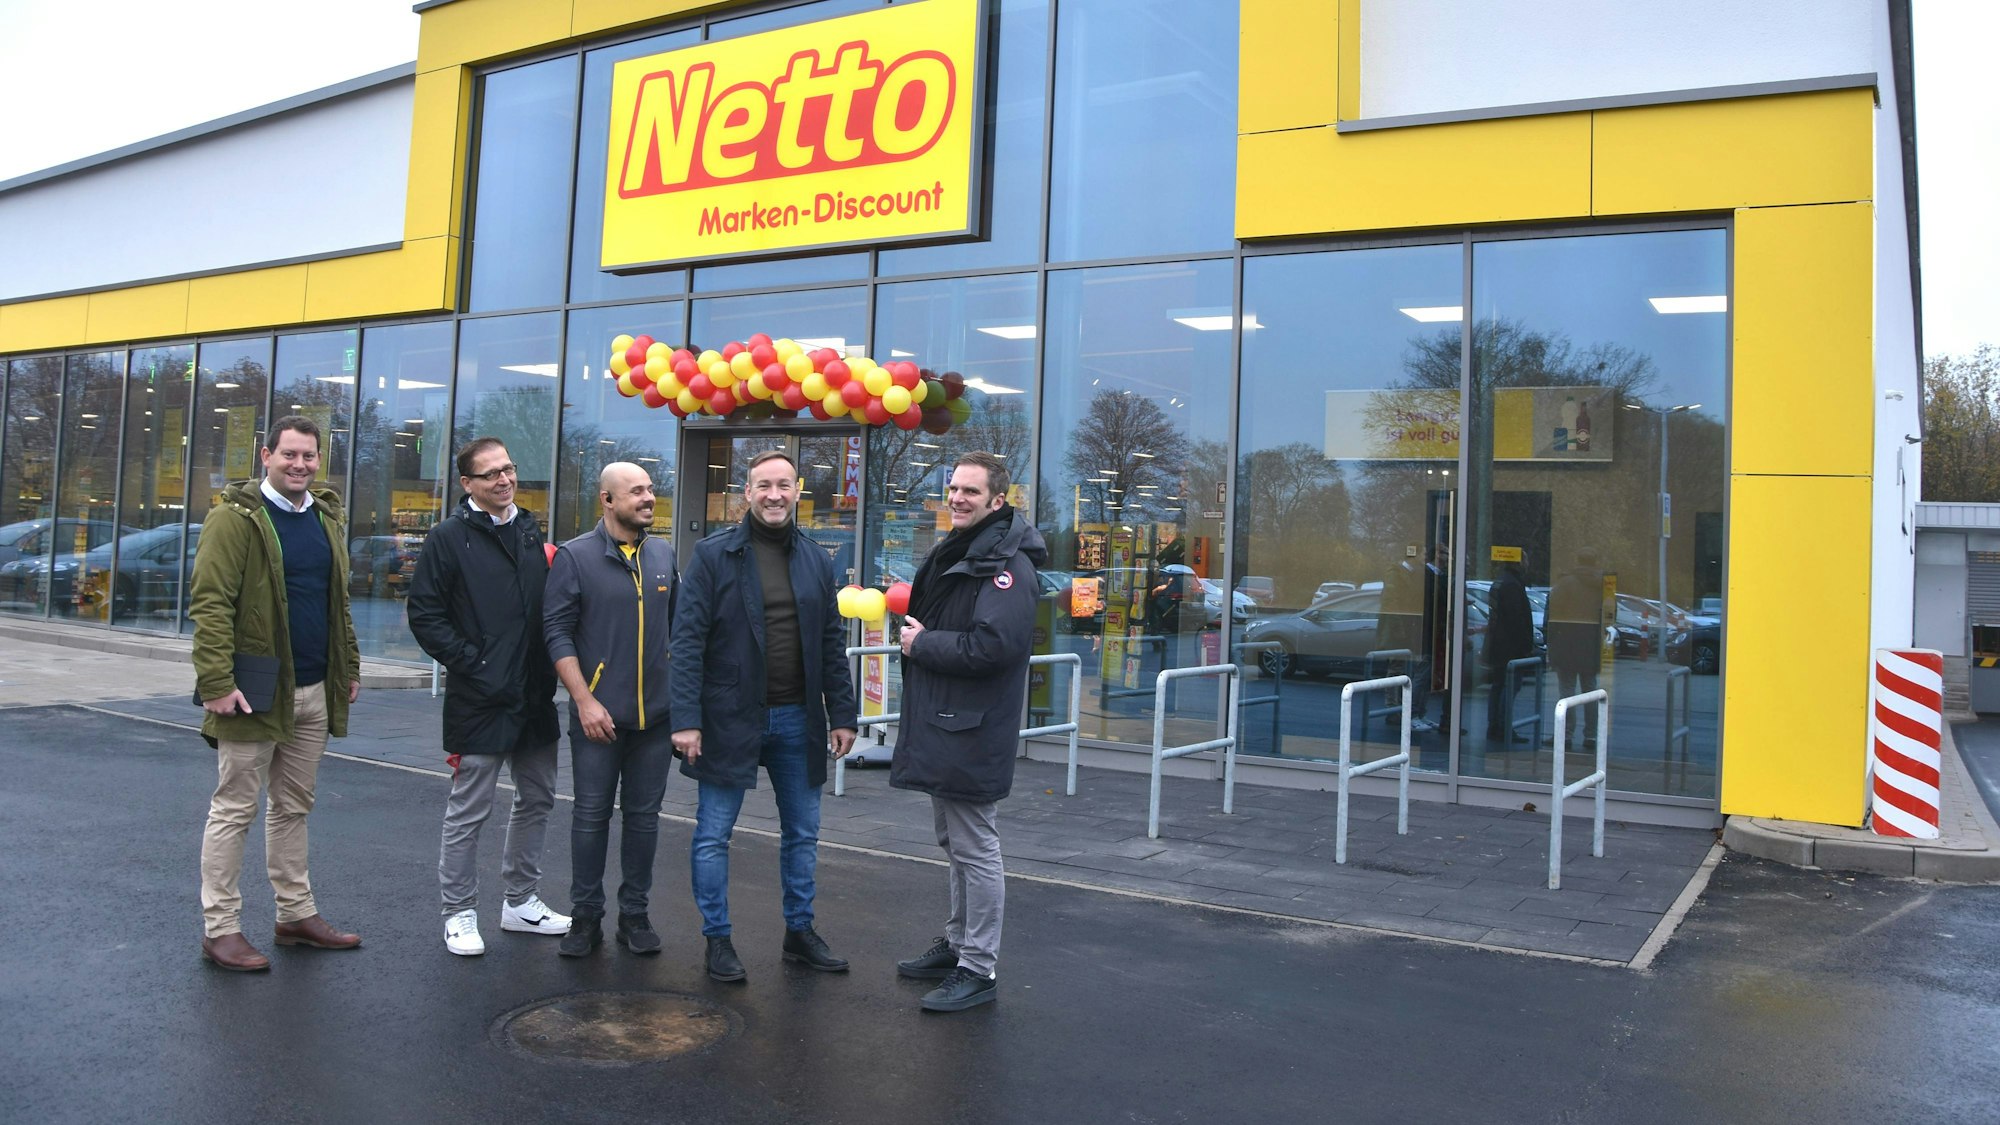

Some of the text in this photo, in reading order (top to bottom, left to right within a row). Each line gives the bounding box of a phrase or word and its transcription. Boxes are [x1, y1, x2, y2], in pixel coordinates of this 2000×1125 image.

[618, 40, 956, 199] Netto
[699, 181, 944, 236] Marken-Discount
[1408, 427, 1435, 441] voll
[1441, 430, 1459, 444] gu
